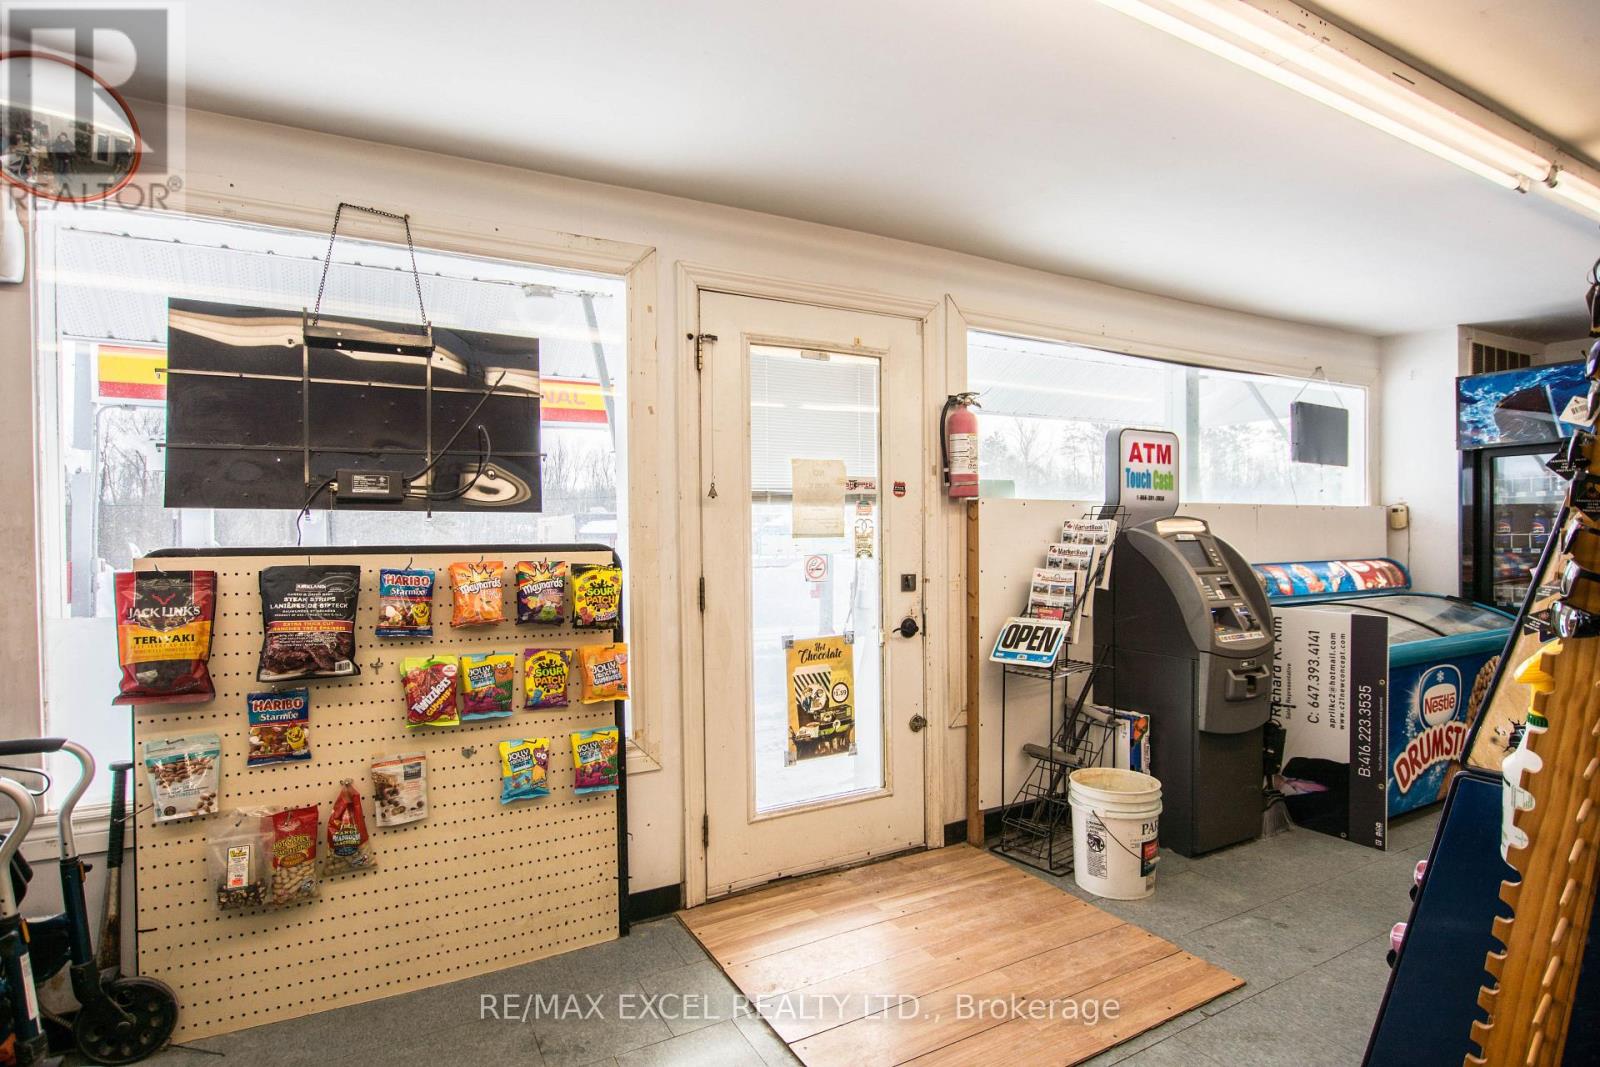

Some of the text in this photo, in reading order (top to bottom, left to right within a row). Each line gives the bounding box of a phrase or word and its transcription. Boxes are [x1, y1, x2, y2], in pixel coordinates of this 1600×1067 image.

[543, 390, 586, 405] NAL
[1128, 442, 1171, 465] ATM
[1125, 467, 1174, 491] Touch Cash
[384, 574, 431, 587] HARIBO
[459, 578, 502, 595] Maynards
[522, 577, 564, 595] Maynards
[586, 586, 615, 596] SOUR
[585, 596, 616, 605] PATCH
[127, 607, 161, 619] JACK
[133, 633, 195, 645] TERIAKI
[1001, 623, 1062, 653] OPEN
[798, 647, 843, 664] Chocolate
[469, 664, 492, 677] JOLLY
[534, 667, 563, 677] SOUR
[592, 660, 617, 674] JOLLY
[534, 676, 565, 687] PATCH
[1307, 630, 1320, 724] C: 647.393.4141
[410, 676, 452, 714] Twizzlers
[1272, 665, 1282, 718] Rchard
[252, 697, 304, 712] HARIBO
[260, 711, 297, 721] Starmix
[1357, 685, 1372, 778] B:416.223.3535
[577, 741, 598, 752] JOLLY
[508, 748, 529, 761] JOLLY
[1395, 725, 1466, 788] DRUMSTI
